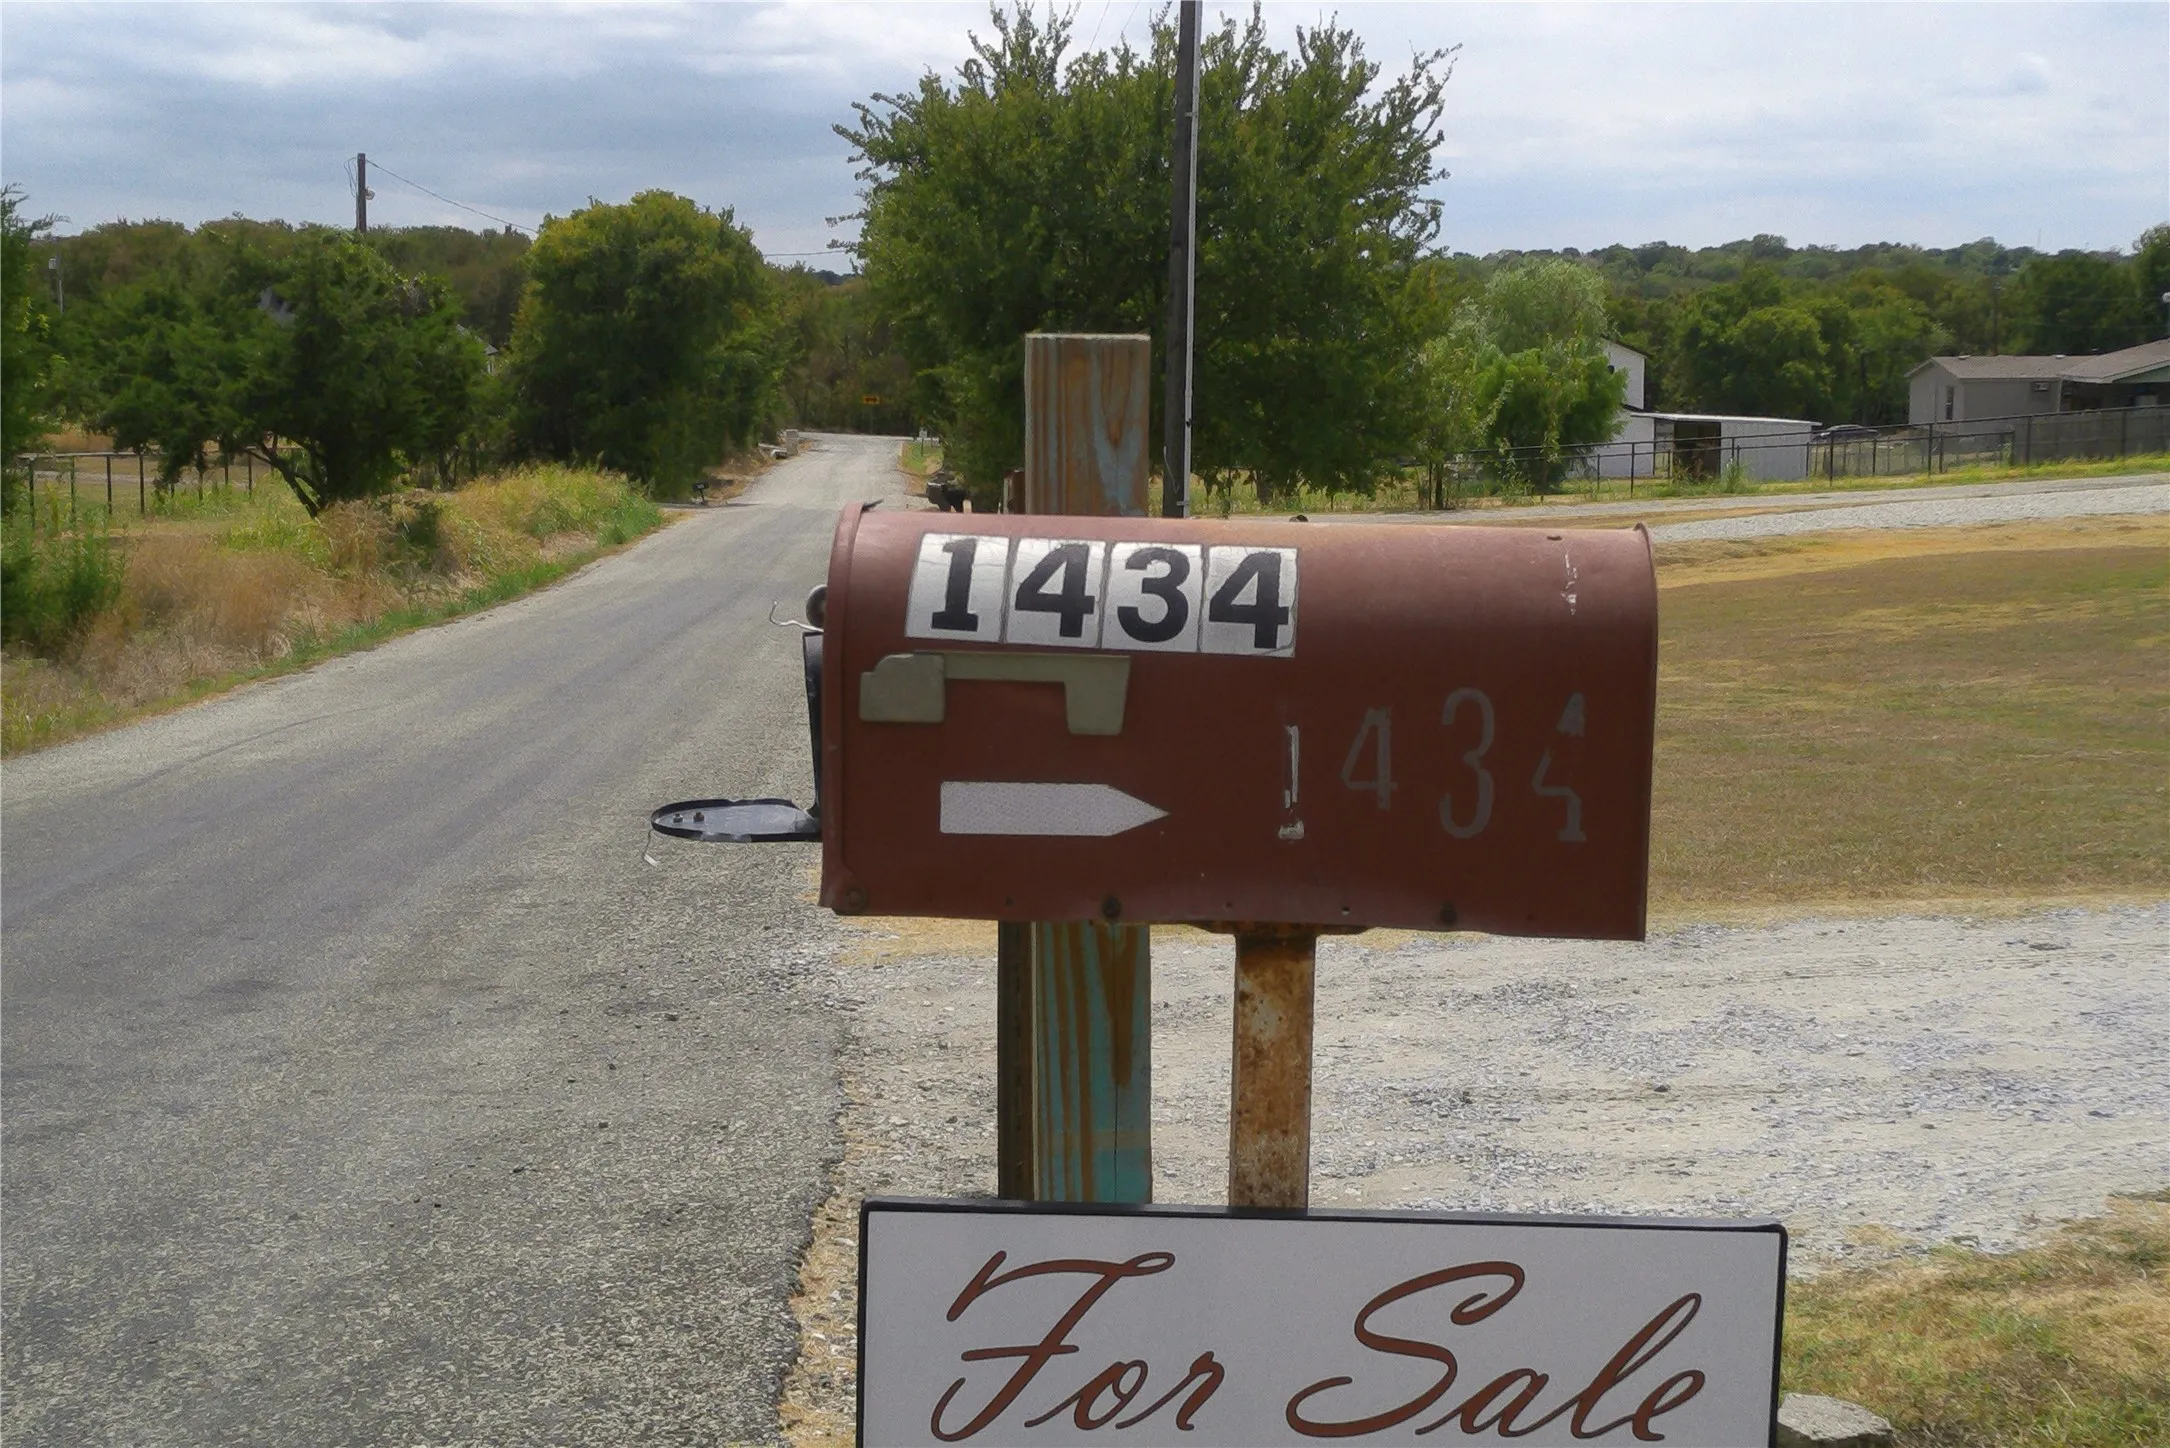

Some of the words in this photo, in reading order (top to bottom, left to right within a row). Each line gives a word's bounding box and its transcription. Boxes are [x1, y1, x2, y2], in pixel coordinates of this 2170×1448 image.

[930, 538, 1290, 649] 1434
[931, 1250, 1225, 1442] For
[1285, 1260, 1707, 1442] Sale
